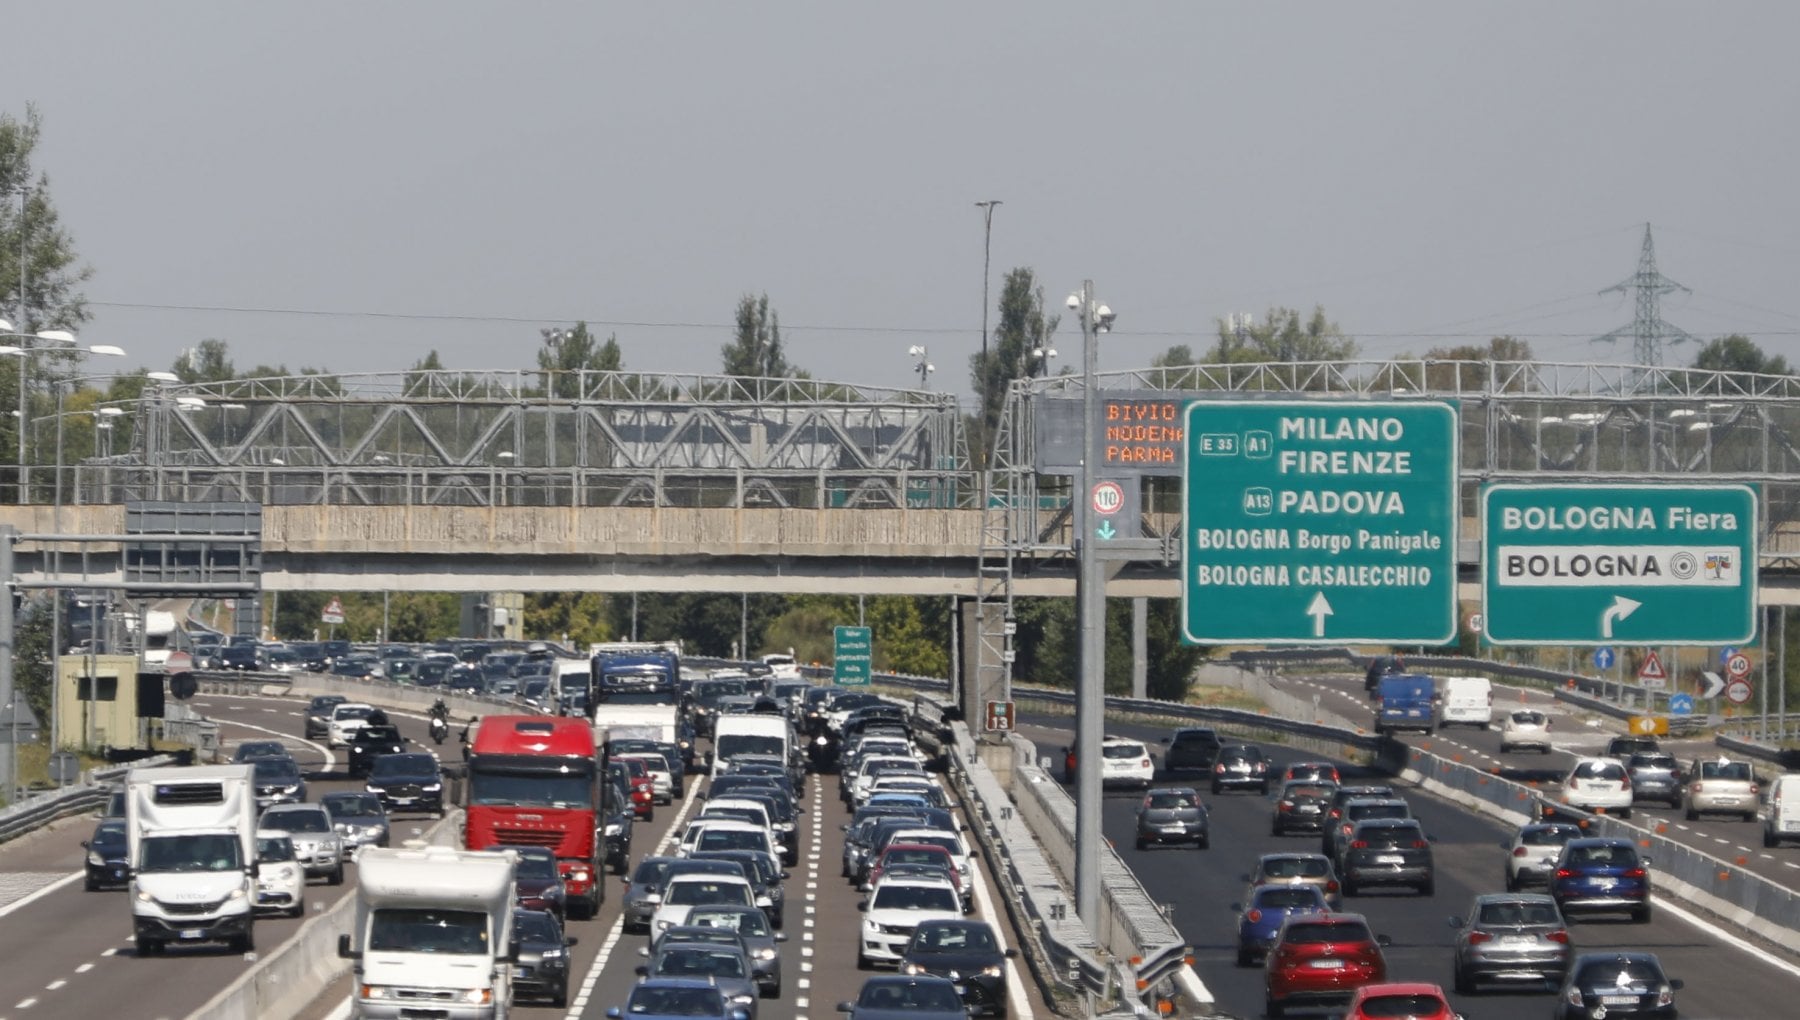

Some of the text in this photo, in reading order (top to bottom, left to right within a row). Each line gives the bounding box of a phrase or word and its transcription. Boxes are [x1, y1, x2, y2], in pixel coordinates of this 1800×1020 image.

[1107, 404, 1176, 421] BIVIO
[1280, 417, 1404, 441] MILANO
[1203, 438, 1233, 451] E 35
[1248, 437, 1268, 452] A1
[1107, 446, 1175, 463] PARMA
[1280, 450, 1412, 475] FIRENZE
[1098, 491, 1117, 506] 110
[1245, 494, 1271, 508] A13
[1279, 490, 1405, 514] PADOVA
[1503, 506, 1738, 530] BOLOGNA Fiera
[1198, 528, 1442, 554] BOLOGNA Borgo Panigale
[1507, 554, 1662, 577] BOLOGNA
[1198, 564, 1431, 587] BOLOGNA CASALECCHIO
[1731, 660, 1746, 671] 40
[992, 716, 1009, 729] 13
